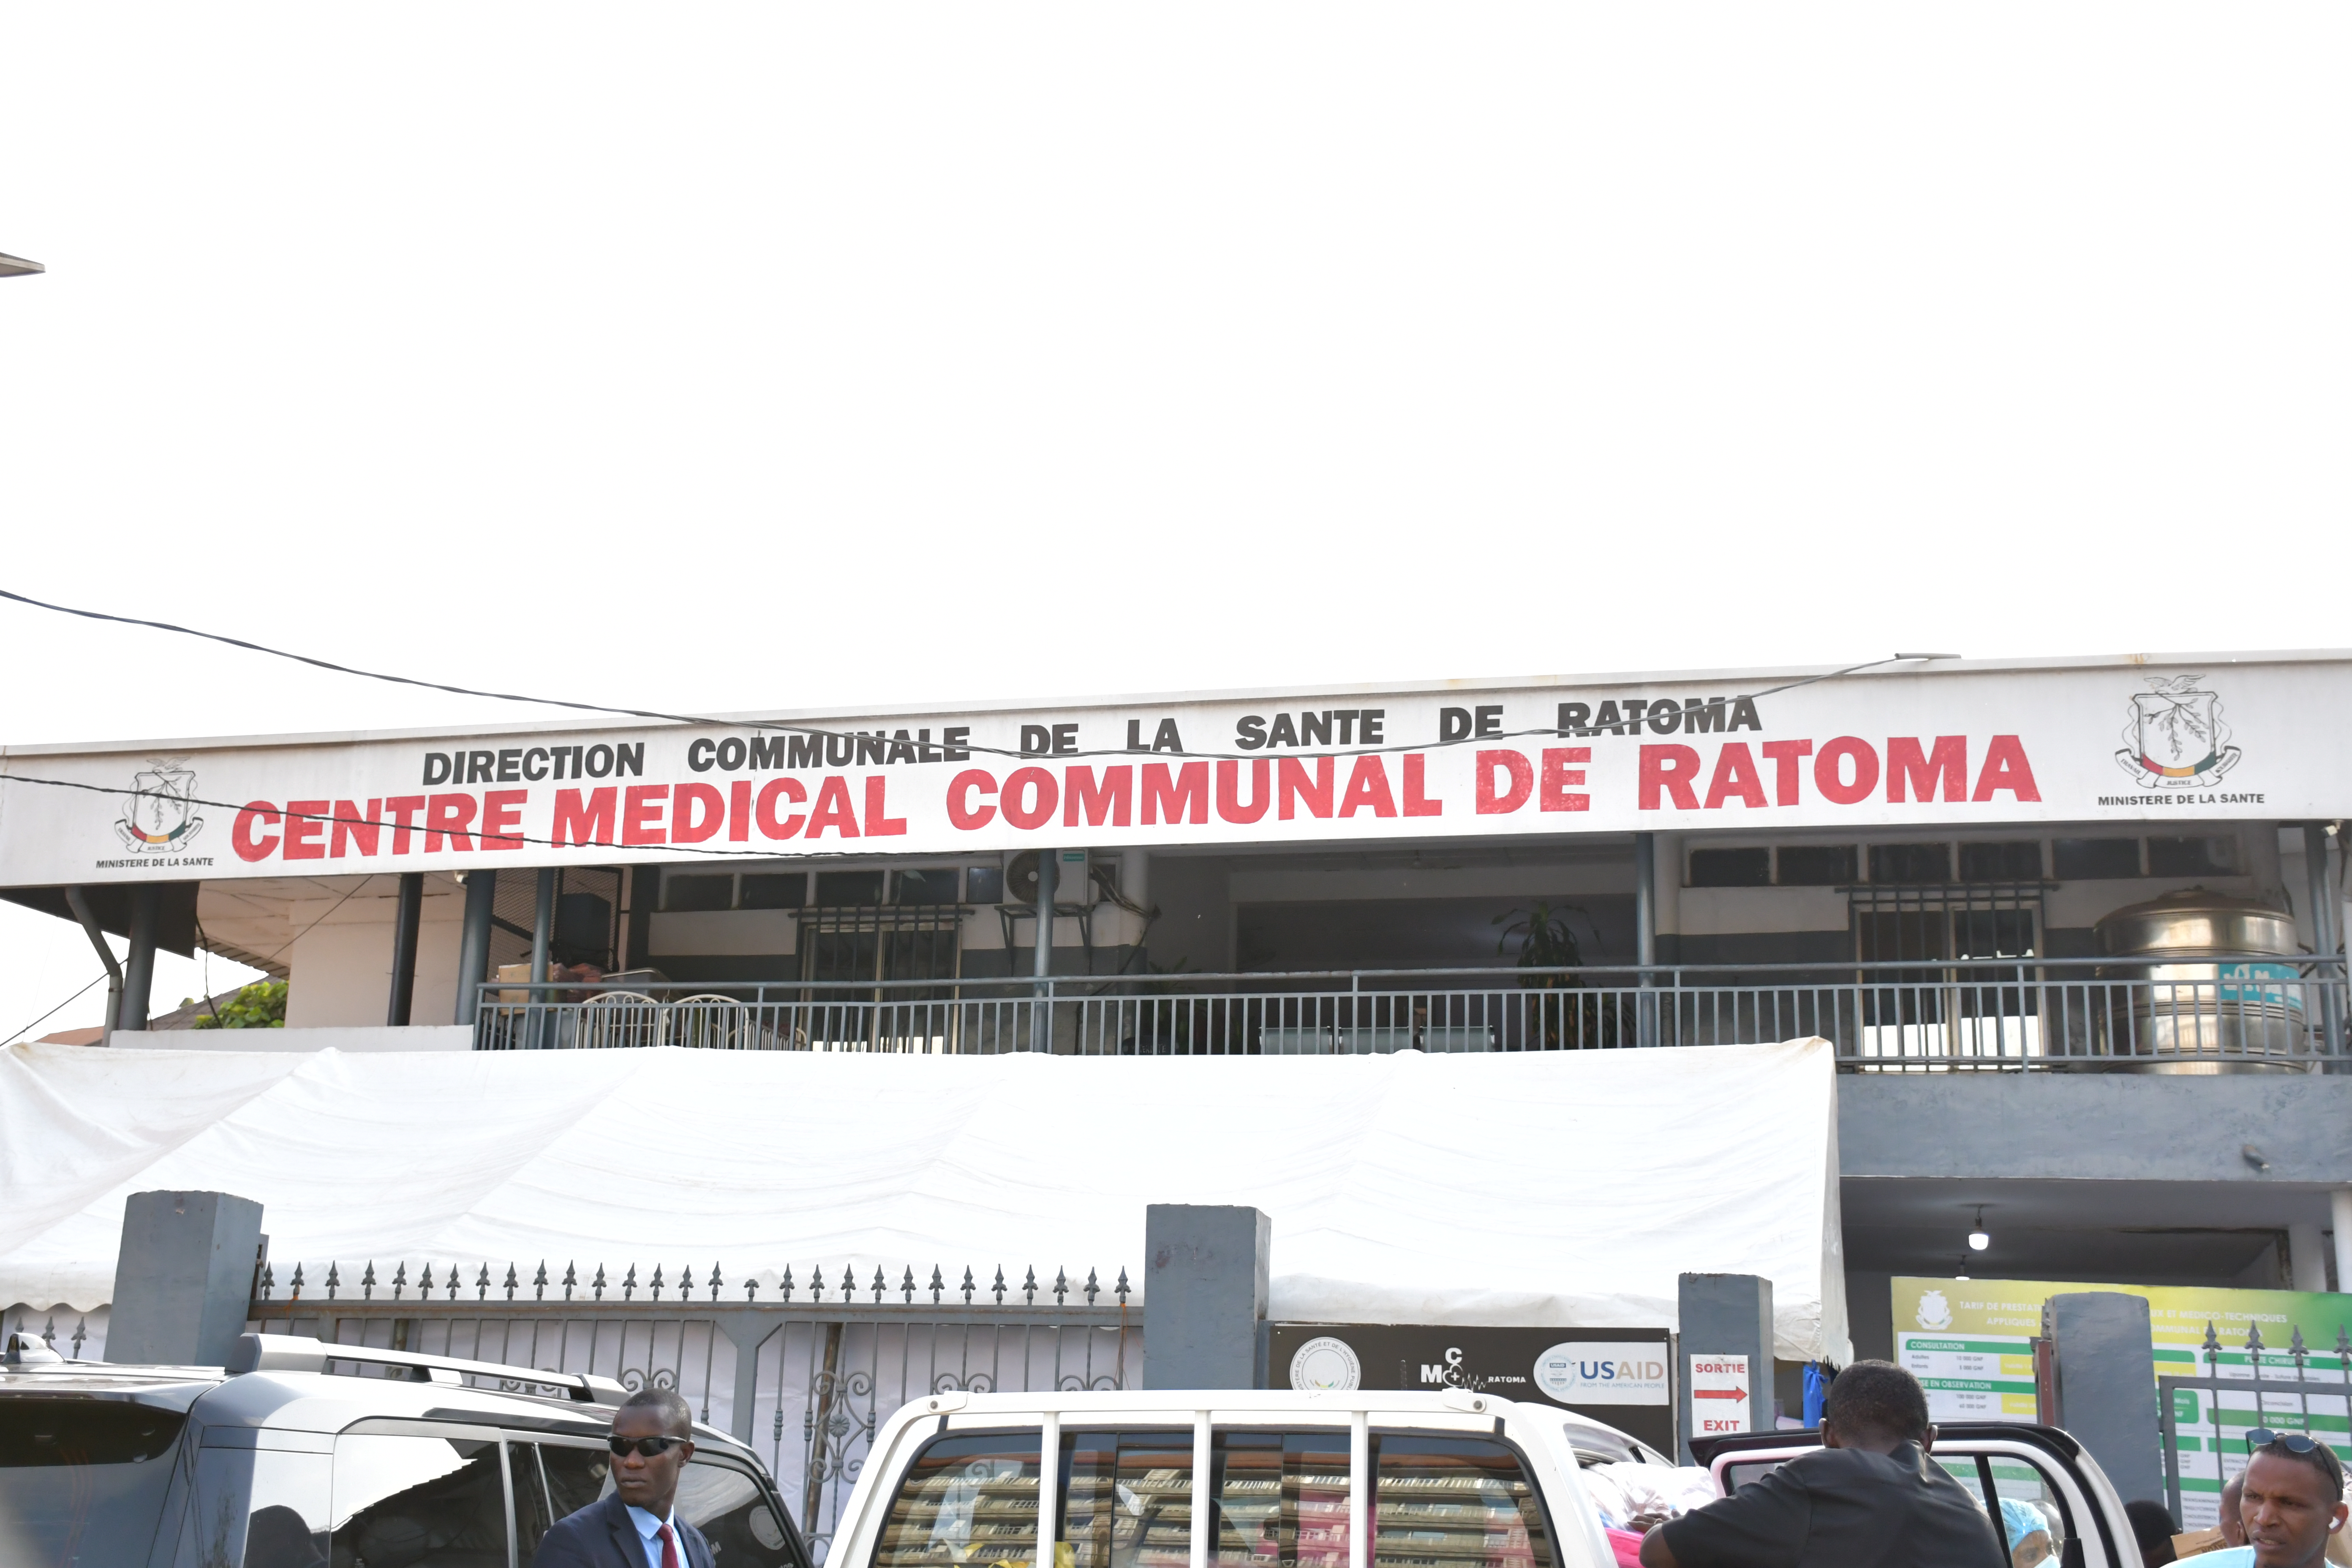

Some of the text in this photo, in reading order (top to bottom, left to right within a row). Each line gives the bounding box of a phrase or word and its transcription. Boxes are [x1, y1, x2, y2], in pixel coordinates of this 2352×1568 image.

[423, 695, 1762, 785] DIRECTION COMMUNALE DE LA SANTE DE RATOMA
[231, 735, 2042, 863] CENTRE MEDICAL COMMUNAL DE RATOMA
[2098, 793, 2265, 806] MINISTERE DE LA SANTE
[96, 858, 214, 868] MINISTERE DE LA SANTE
[1960, 1301, 2043, 1312] TARIF DE PRESTATI
[2151, 1309, 2288, 1323] UX ET MEDICO-TECHNIQUES
[1987, 1317, 2036, 1327] APPLIQUES
[1305, 1341, 1322, 1353] SANTÉ
[1910, 1341, 1965, 1350] CONSULTATION
[1580, 1361, 1663, 1380] USAID
[1695, 1363, 1745, 1373] SORTIE
[1941, 1380, 1992, 1390] OBSERVATION
[1703, 1420, 1740, 1431] EXIT
